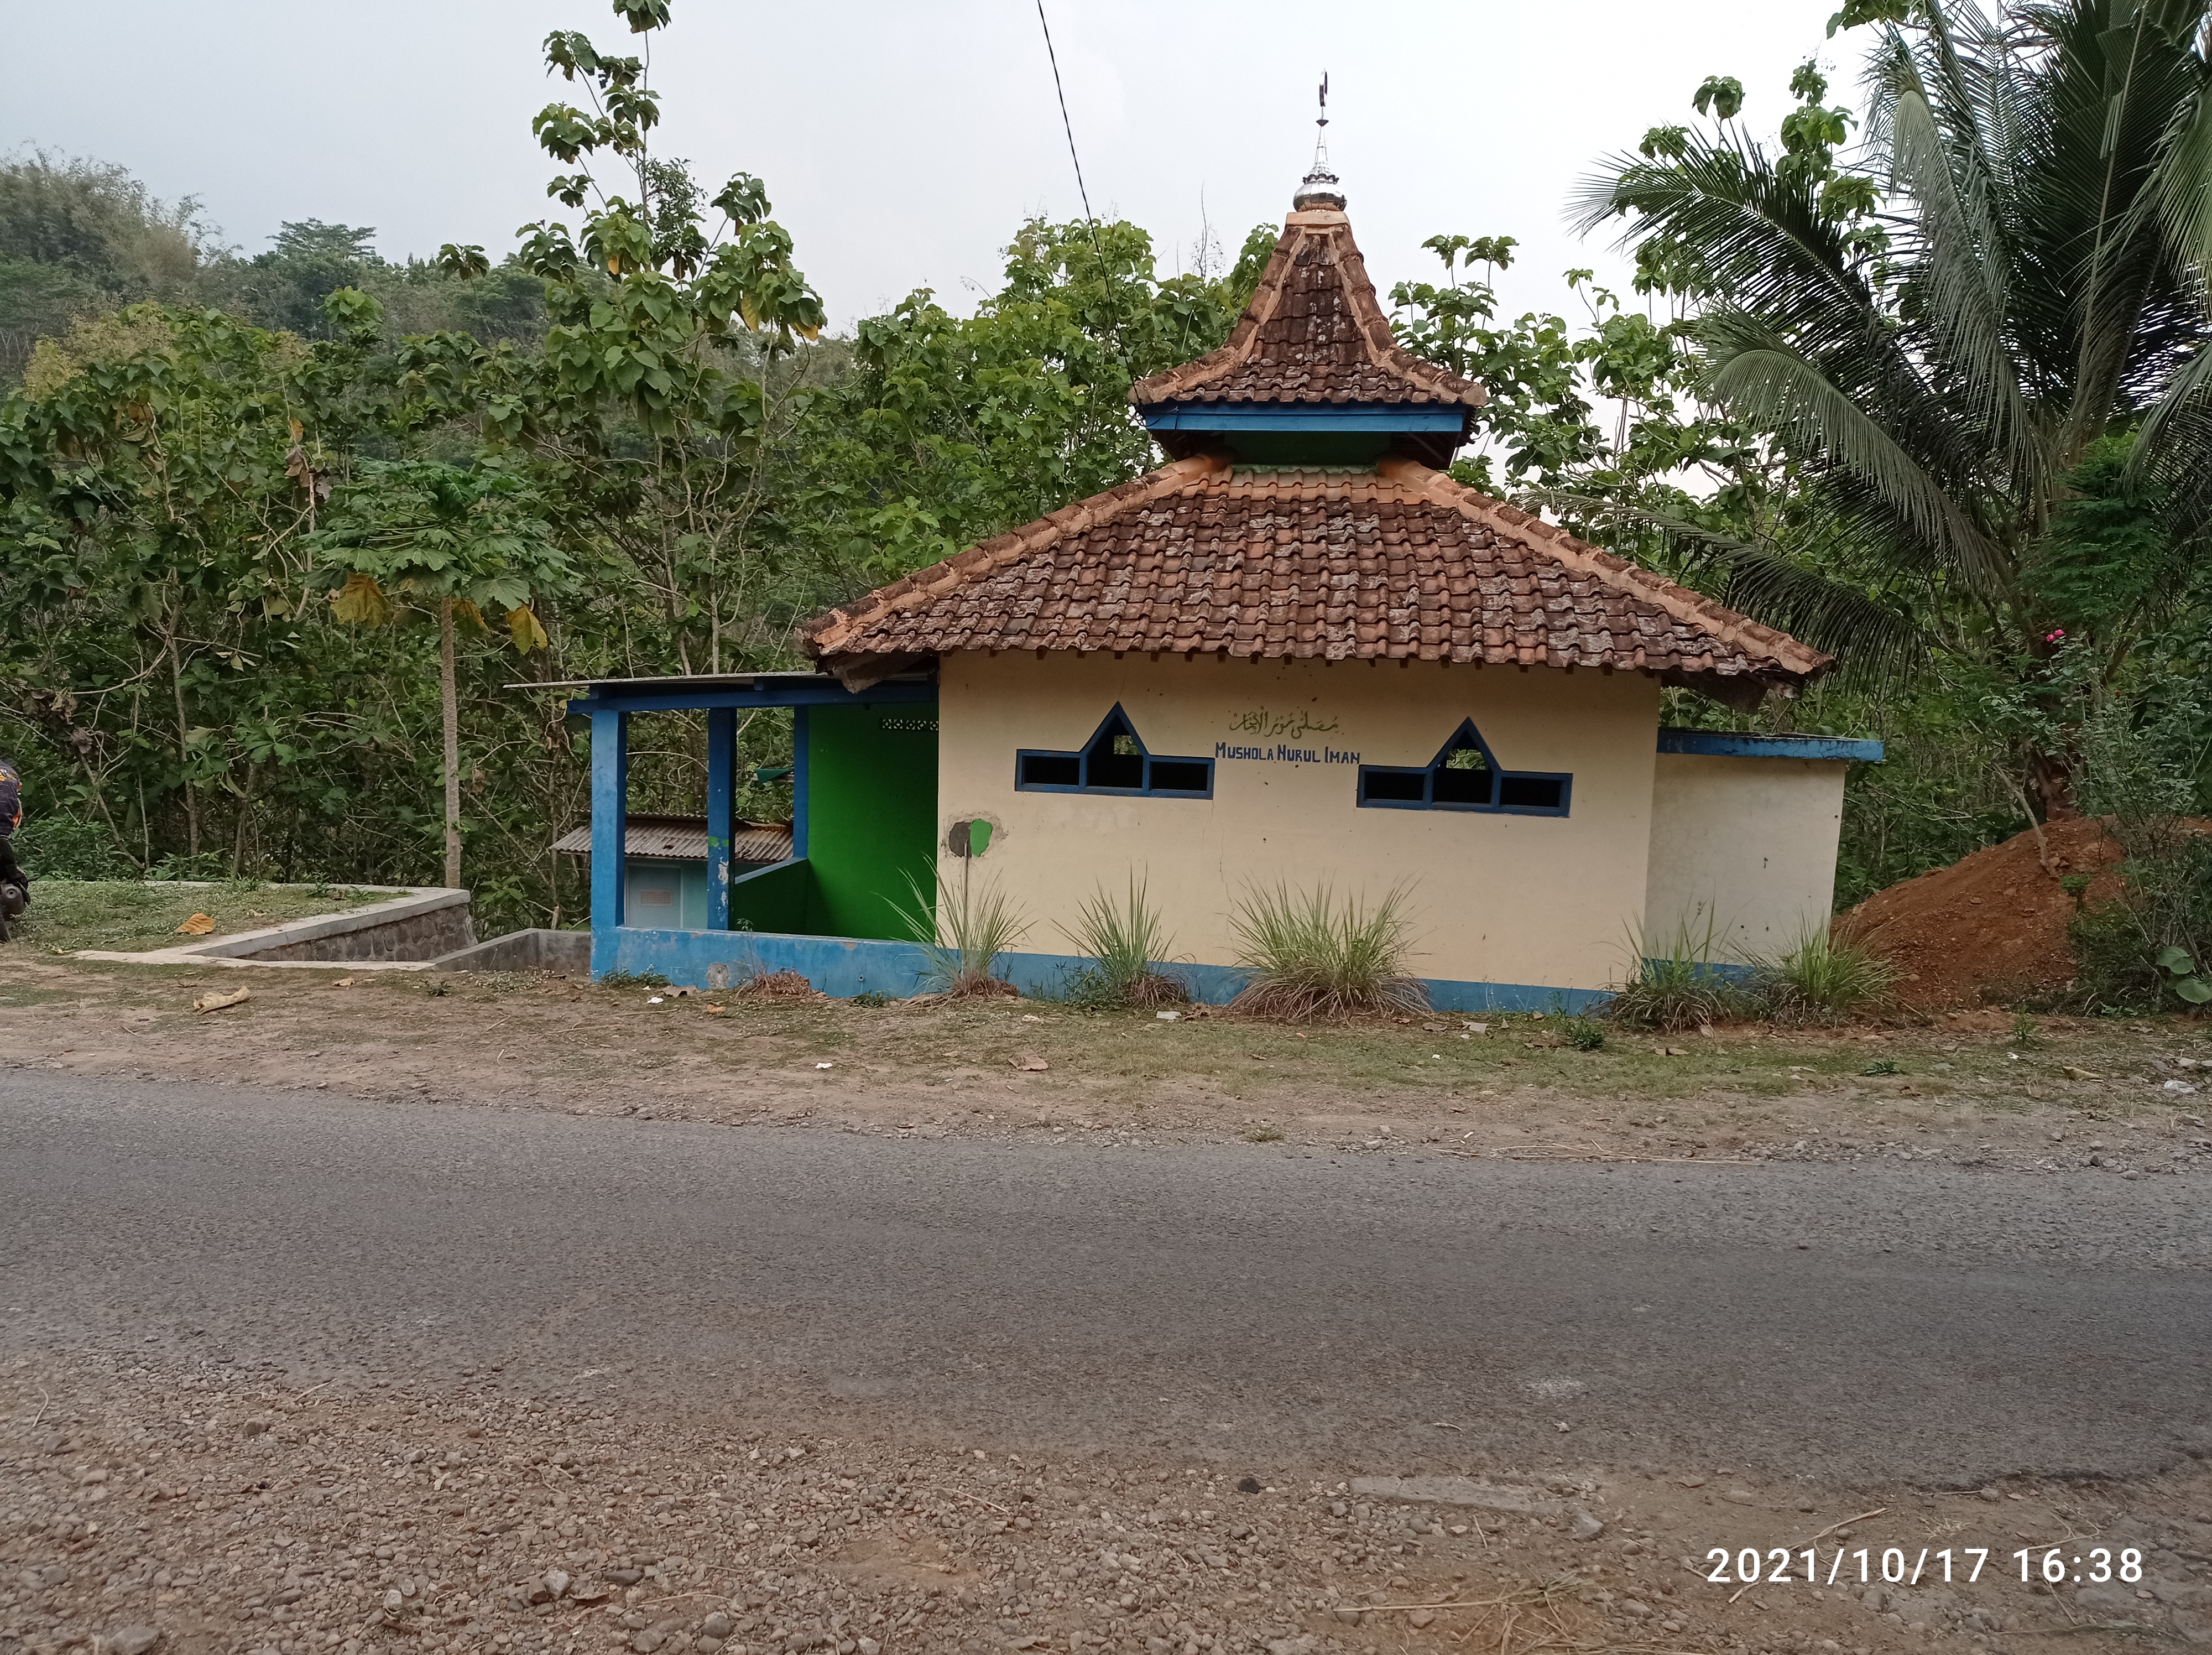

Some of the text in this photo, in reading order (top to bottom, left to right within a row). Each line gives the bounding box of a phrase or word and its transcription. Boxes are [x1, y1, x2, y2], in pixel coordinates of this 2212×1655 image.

[1215, 742, 1360, 764] MUSHOLA NURUL IMAN
